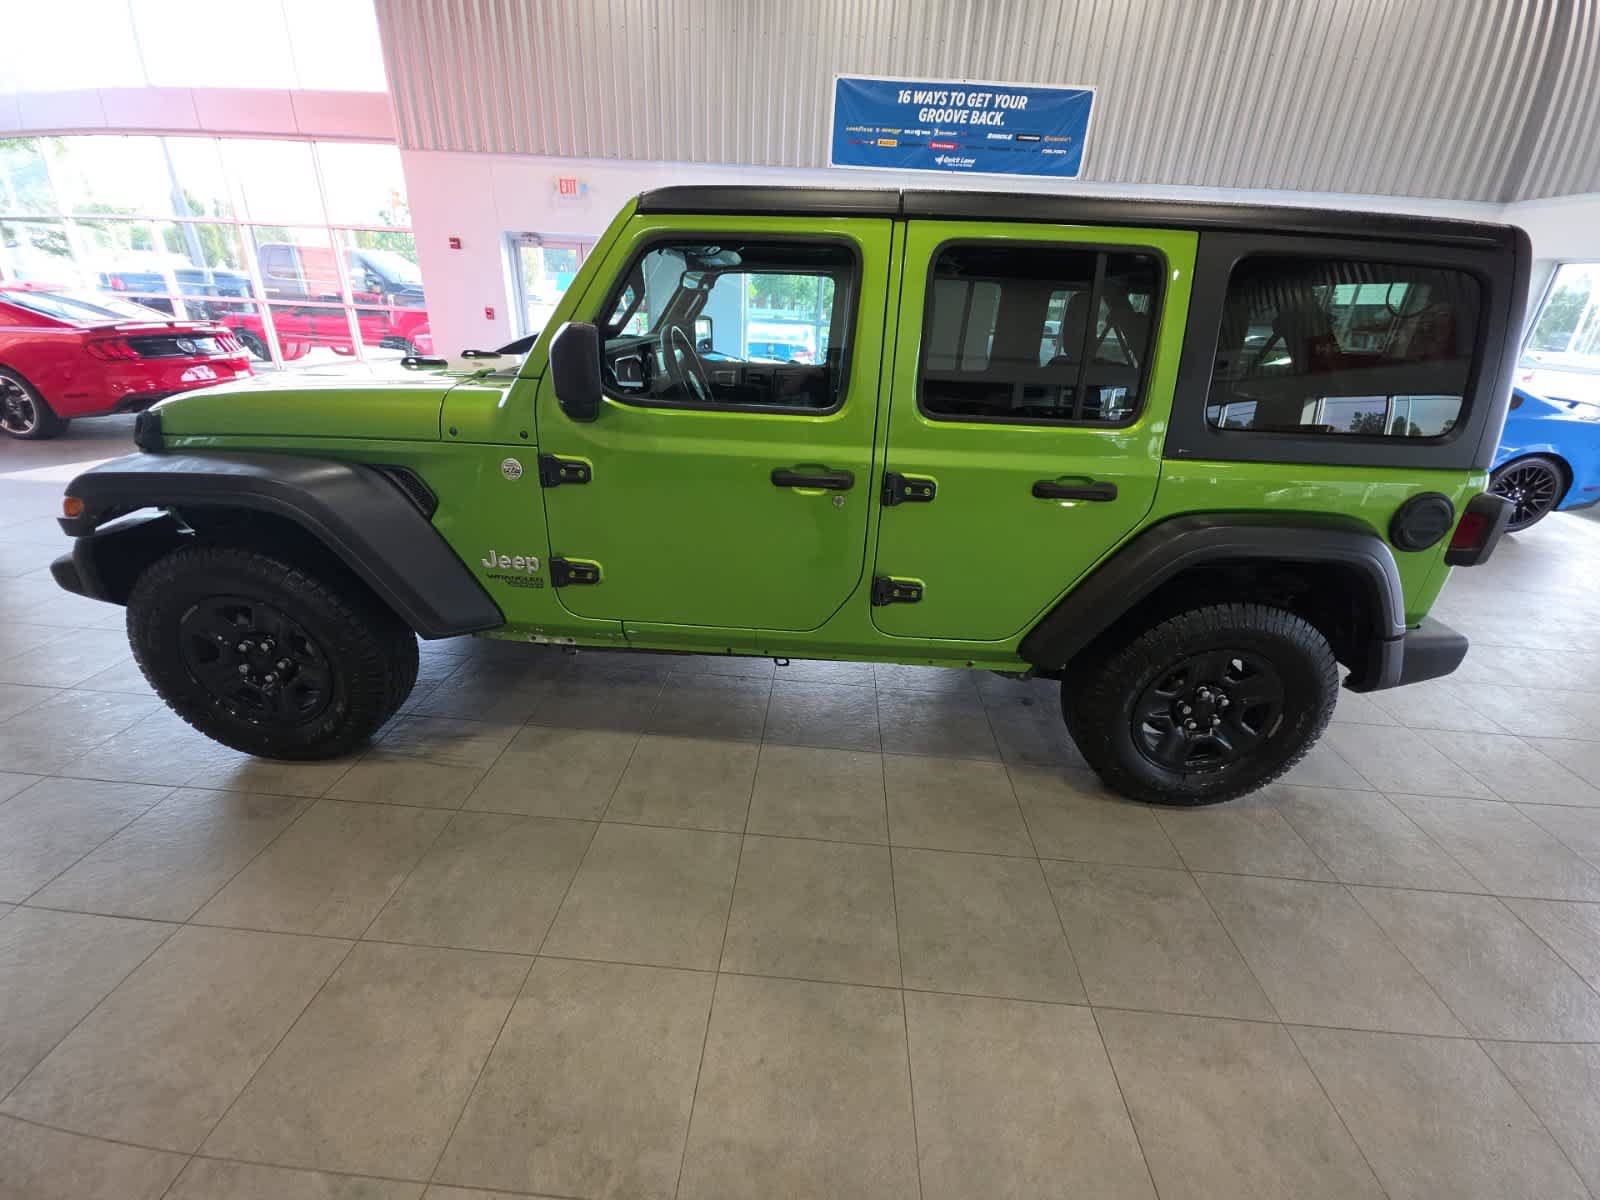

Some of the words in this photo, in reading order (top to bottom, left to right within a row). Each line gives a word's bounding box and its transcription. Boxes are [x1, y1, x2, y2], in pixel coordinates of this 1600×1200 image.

[897, 90, 912, 104] 16
[913, 90, 949, 106] WAYS
[949, 91, 966, 107] TO
[967, 92, 993, 108] GET
[993, 94, 1028, 110] YOUR
[918, 107, 970, 125] GROOVE
[969, 110, 1006, 127] BACK.
[481, 550, 539, 574] Jeep
